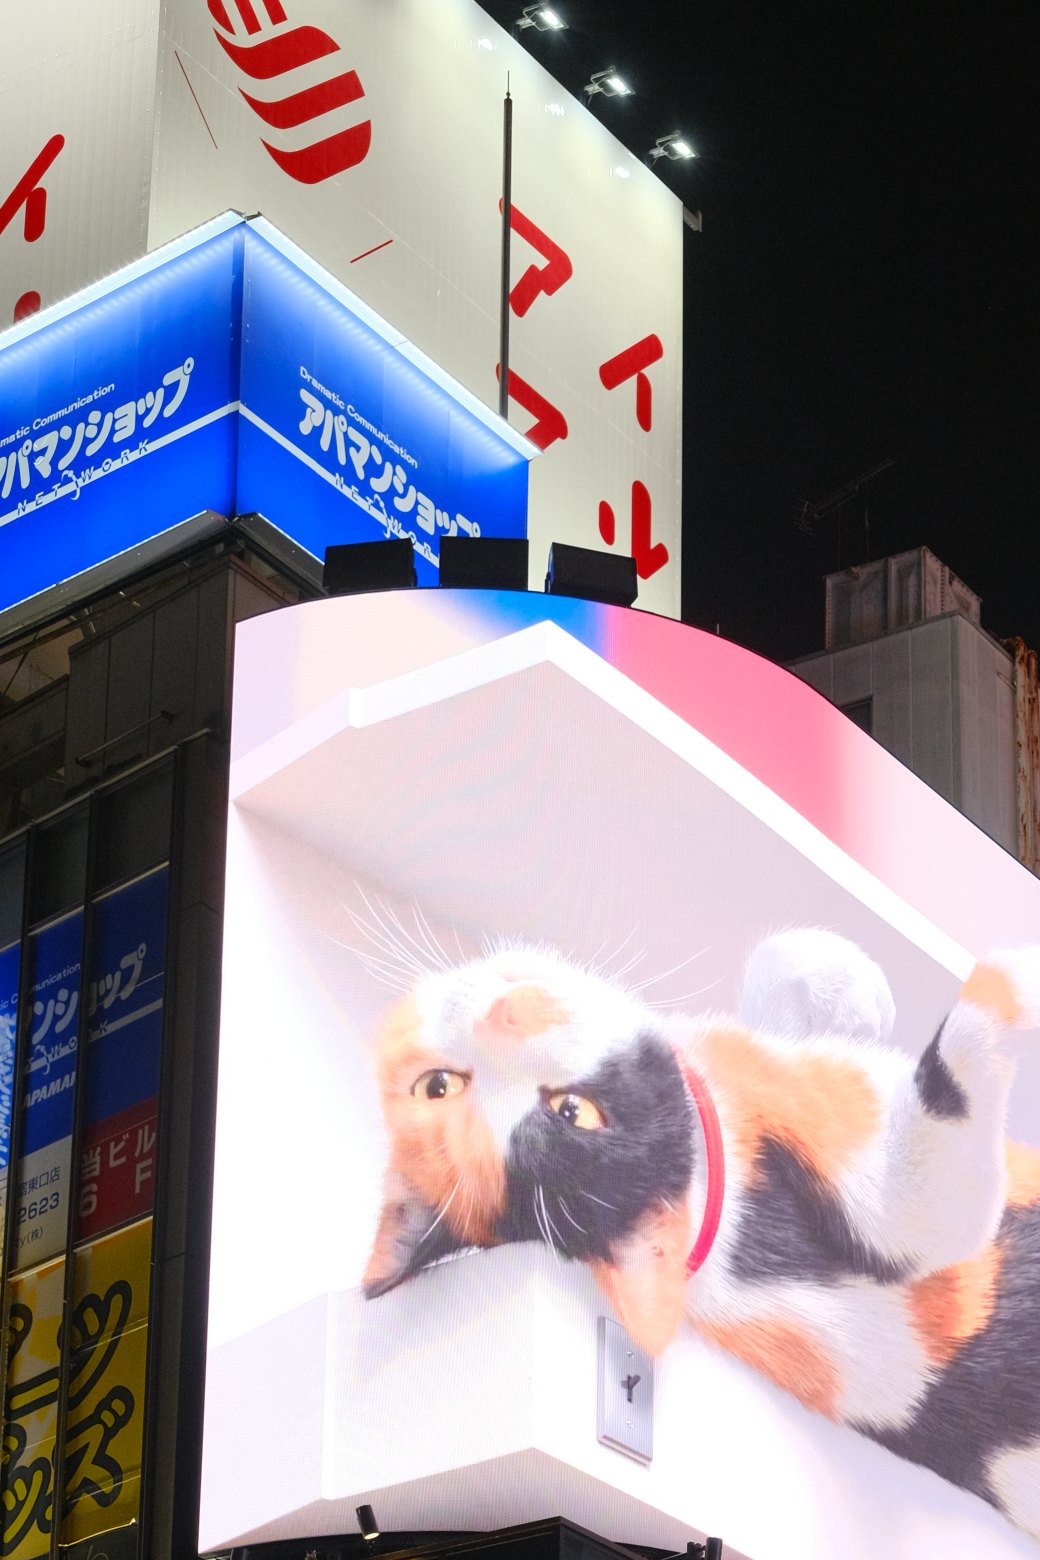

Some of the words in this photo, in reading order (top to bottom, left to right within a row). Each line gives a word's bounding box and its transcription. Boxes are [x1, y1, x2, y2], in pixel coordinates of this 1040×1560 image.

[32, 383, 115, 430] Communication
[300, 366, 345, 410] Dramatic
[346, 404, 418, 469] Communication
